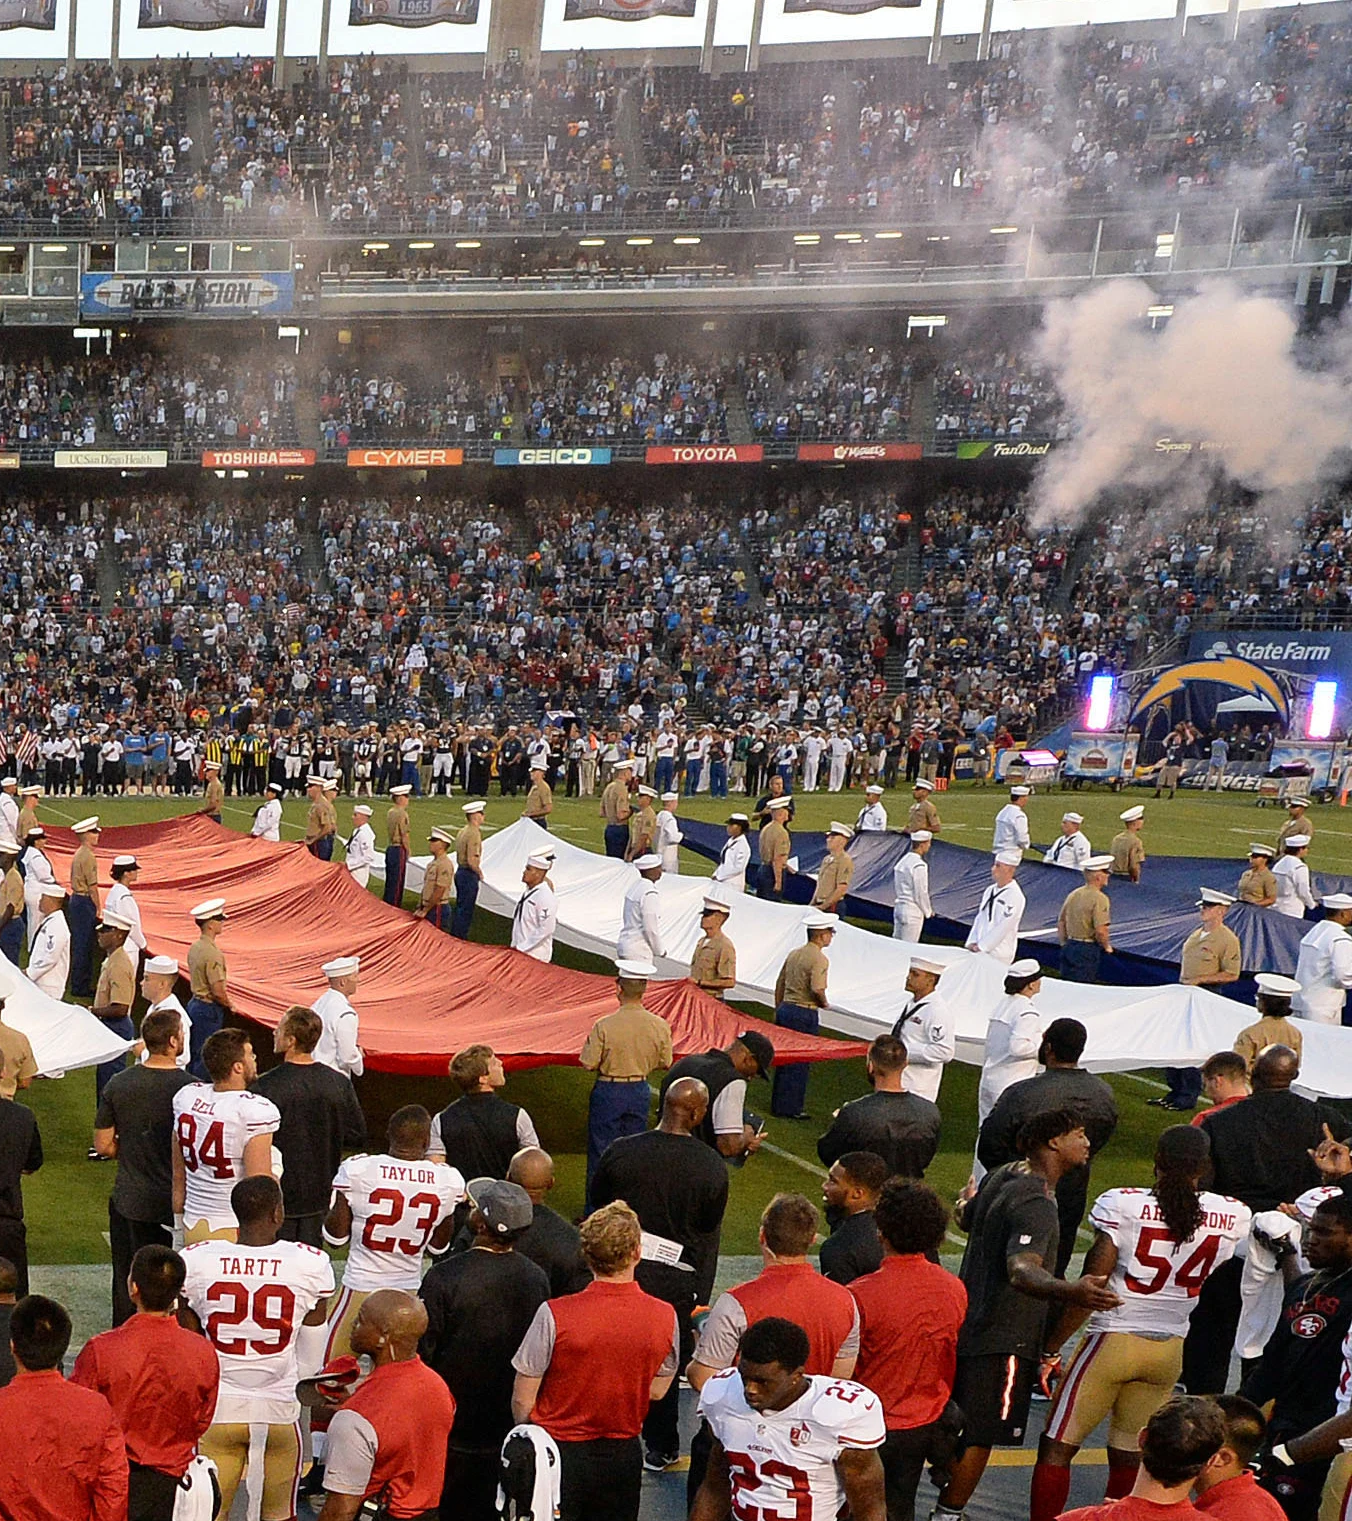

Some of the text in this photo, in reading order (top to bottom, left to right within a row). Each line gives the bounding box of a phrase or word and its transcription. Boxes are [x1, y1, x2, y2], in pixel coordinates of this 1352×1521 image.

[400, 1, 429, 13] 1965
[213, 451, 278, 465] TOSHIBA
[364, 450, 446, 464] CYMER
[518, 448, 592, 464] GEICO
[672, 448, 737, 461] TOYOTA
[993, 443, 1050, 456] FanDuel
[69, 454, 152, 466] UC San Diego Health
[191, 1098, 216, 1116] BELL
[177, 1112, 236, 1179] 84
[379, 1164, 436, 1185] TAYLOR
[361, 1187, 441, 1256] 23
[219, 1257, 282, 1277] TARTT
[1123, 1226, 1223, 1299] 54
[206, 1281, 296, 1356] 29
[726, 1450, 813, 1521] 23
